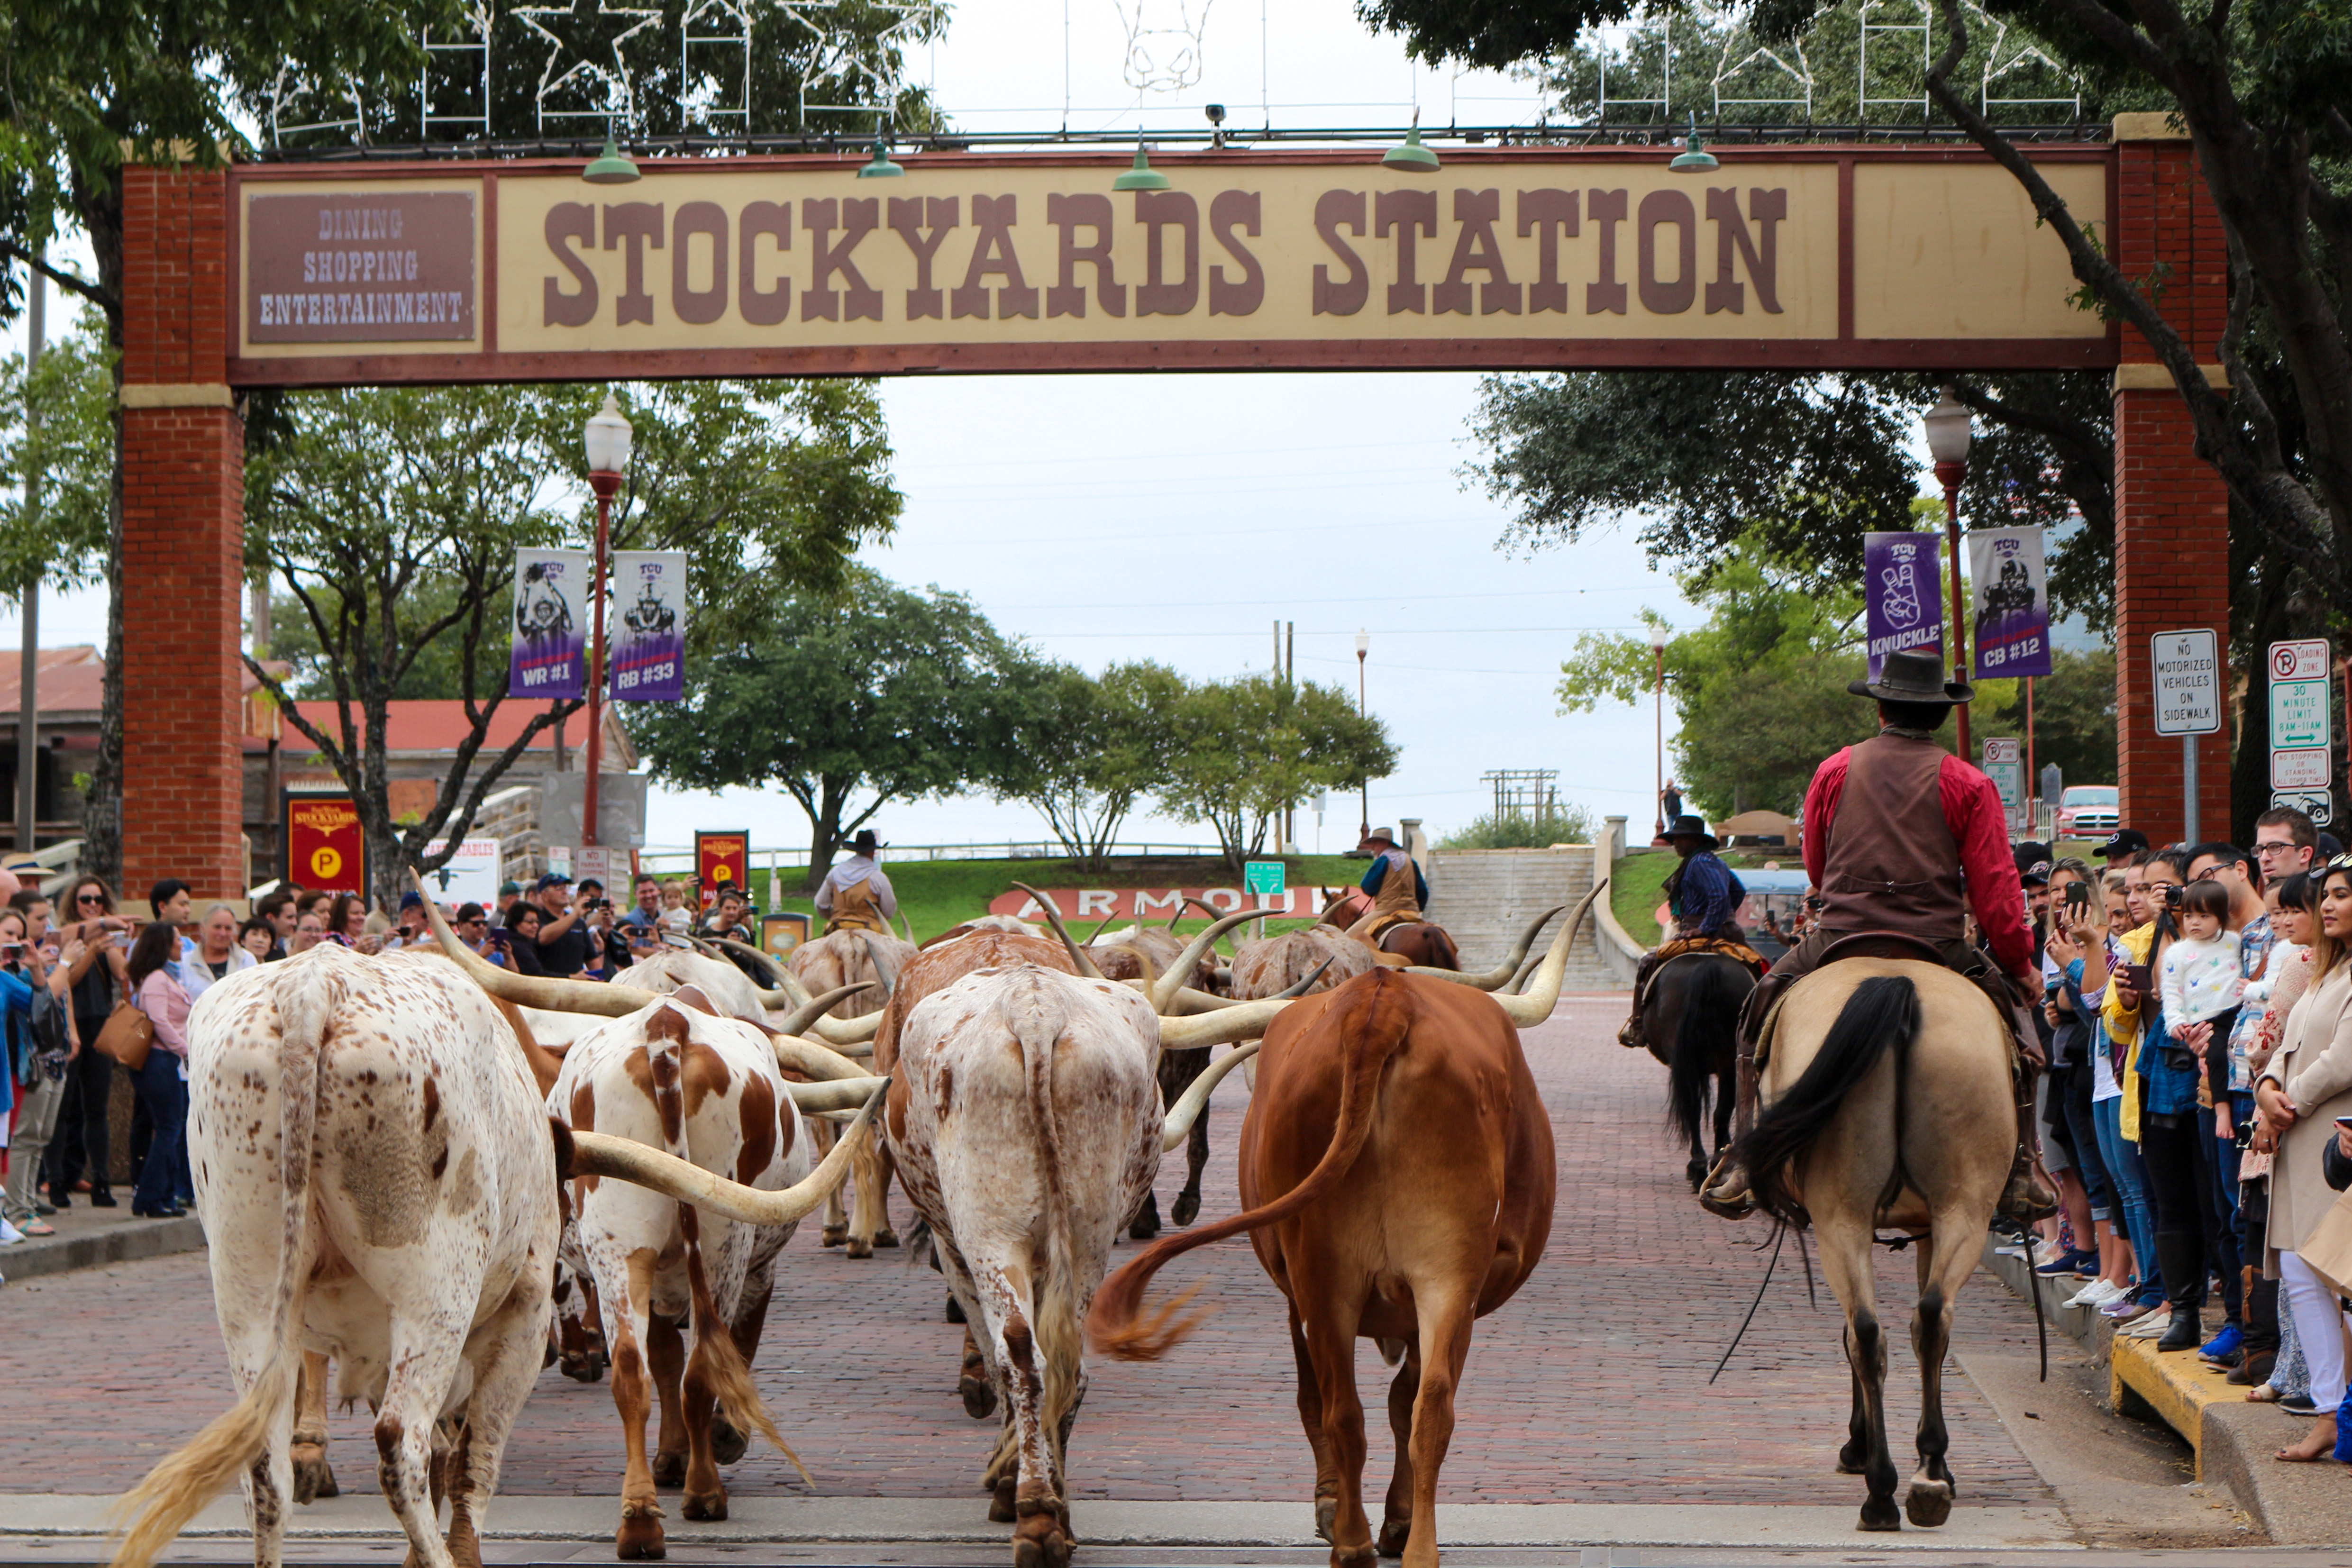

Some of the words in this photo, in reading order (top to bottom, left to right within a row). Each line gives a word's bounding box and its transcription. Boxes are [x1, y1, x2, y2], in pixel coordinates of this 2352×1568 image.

[319, 209, 403, 240] DINING
[544, 190, 1265, 327] STOCKYARDS
[1313, 186, 1787, 317] STATION
[304, 250, 418, 283] SHOPPING
[260, 292, 462, 325] ENTERTAINMENT
[1890, 544, 1916, 556] TCU
[1994, 539, 2019, 551] TCU
[542, 563, 564, 573] TCU
[640, 563, 662, 574] TCU
[1871, 624, 1939, 656] KNUCKLE
[1984, 647, 2006, 668] CB
[2009, 637, 2040, 661] #12
[2178, 644, 2191, 656] NO
[2298, 648, 2324, 659] LOADING
[2158, 659, 2213, 673] MOTORIZED
[2302, 662, 2319, 673] ZONE
[522, 666, 548, 687] WR
[551, 663, 570, 682] #1
[618, 669, 639, 690] RB
[642, 662, 675, 684] #33
[2163, 675, 2210, 689] VEHICLES
[2293, 685, 2306, 696] 30
[2180, 692, 2193, 704] ON
[2283, 697, 2316, 709] MINUTE
[2164, 707, 2211, 721] SIDEWALK
[2287, 709, 2311, 720] LIMIT
[2290, 752, 2323, 760] STOPPING
[2285, 768, 2317, 776] STANDING
[586, 851, 599, 859] NO
[319, 854, 333, 872] P
